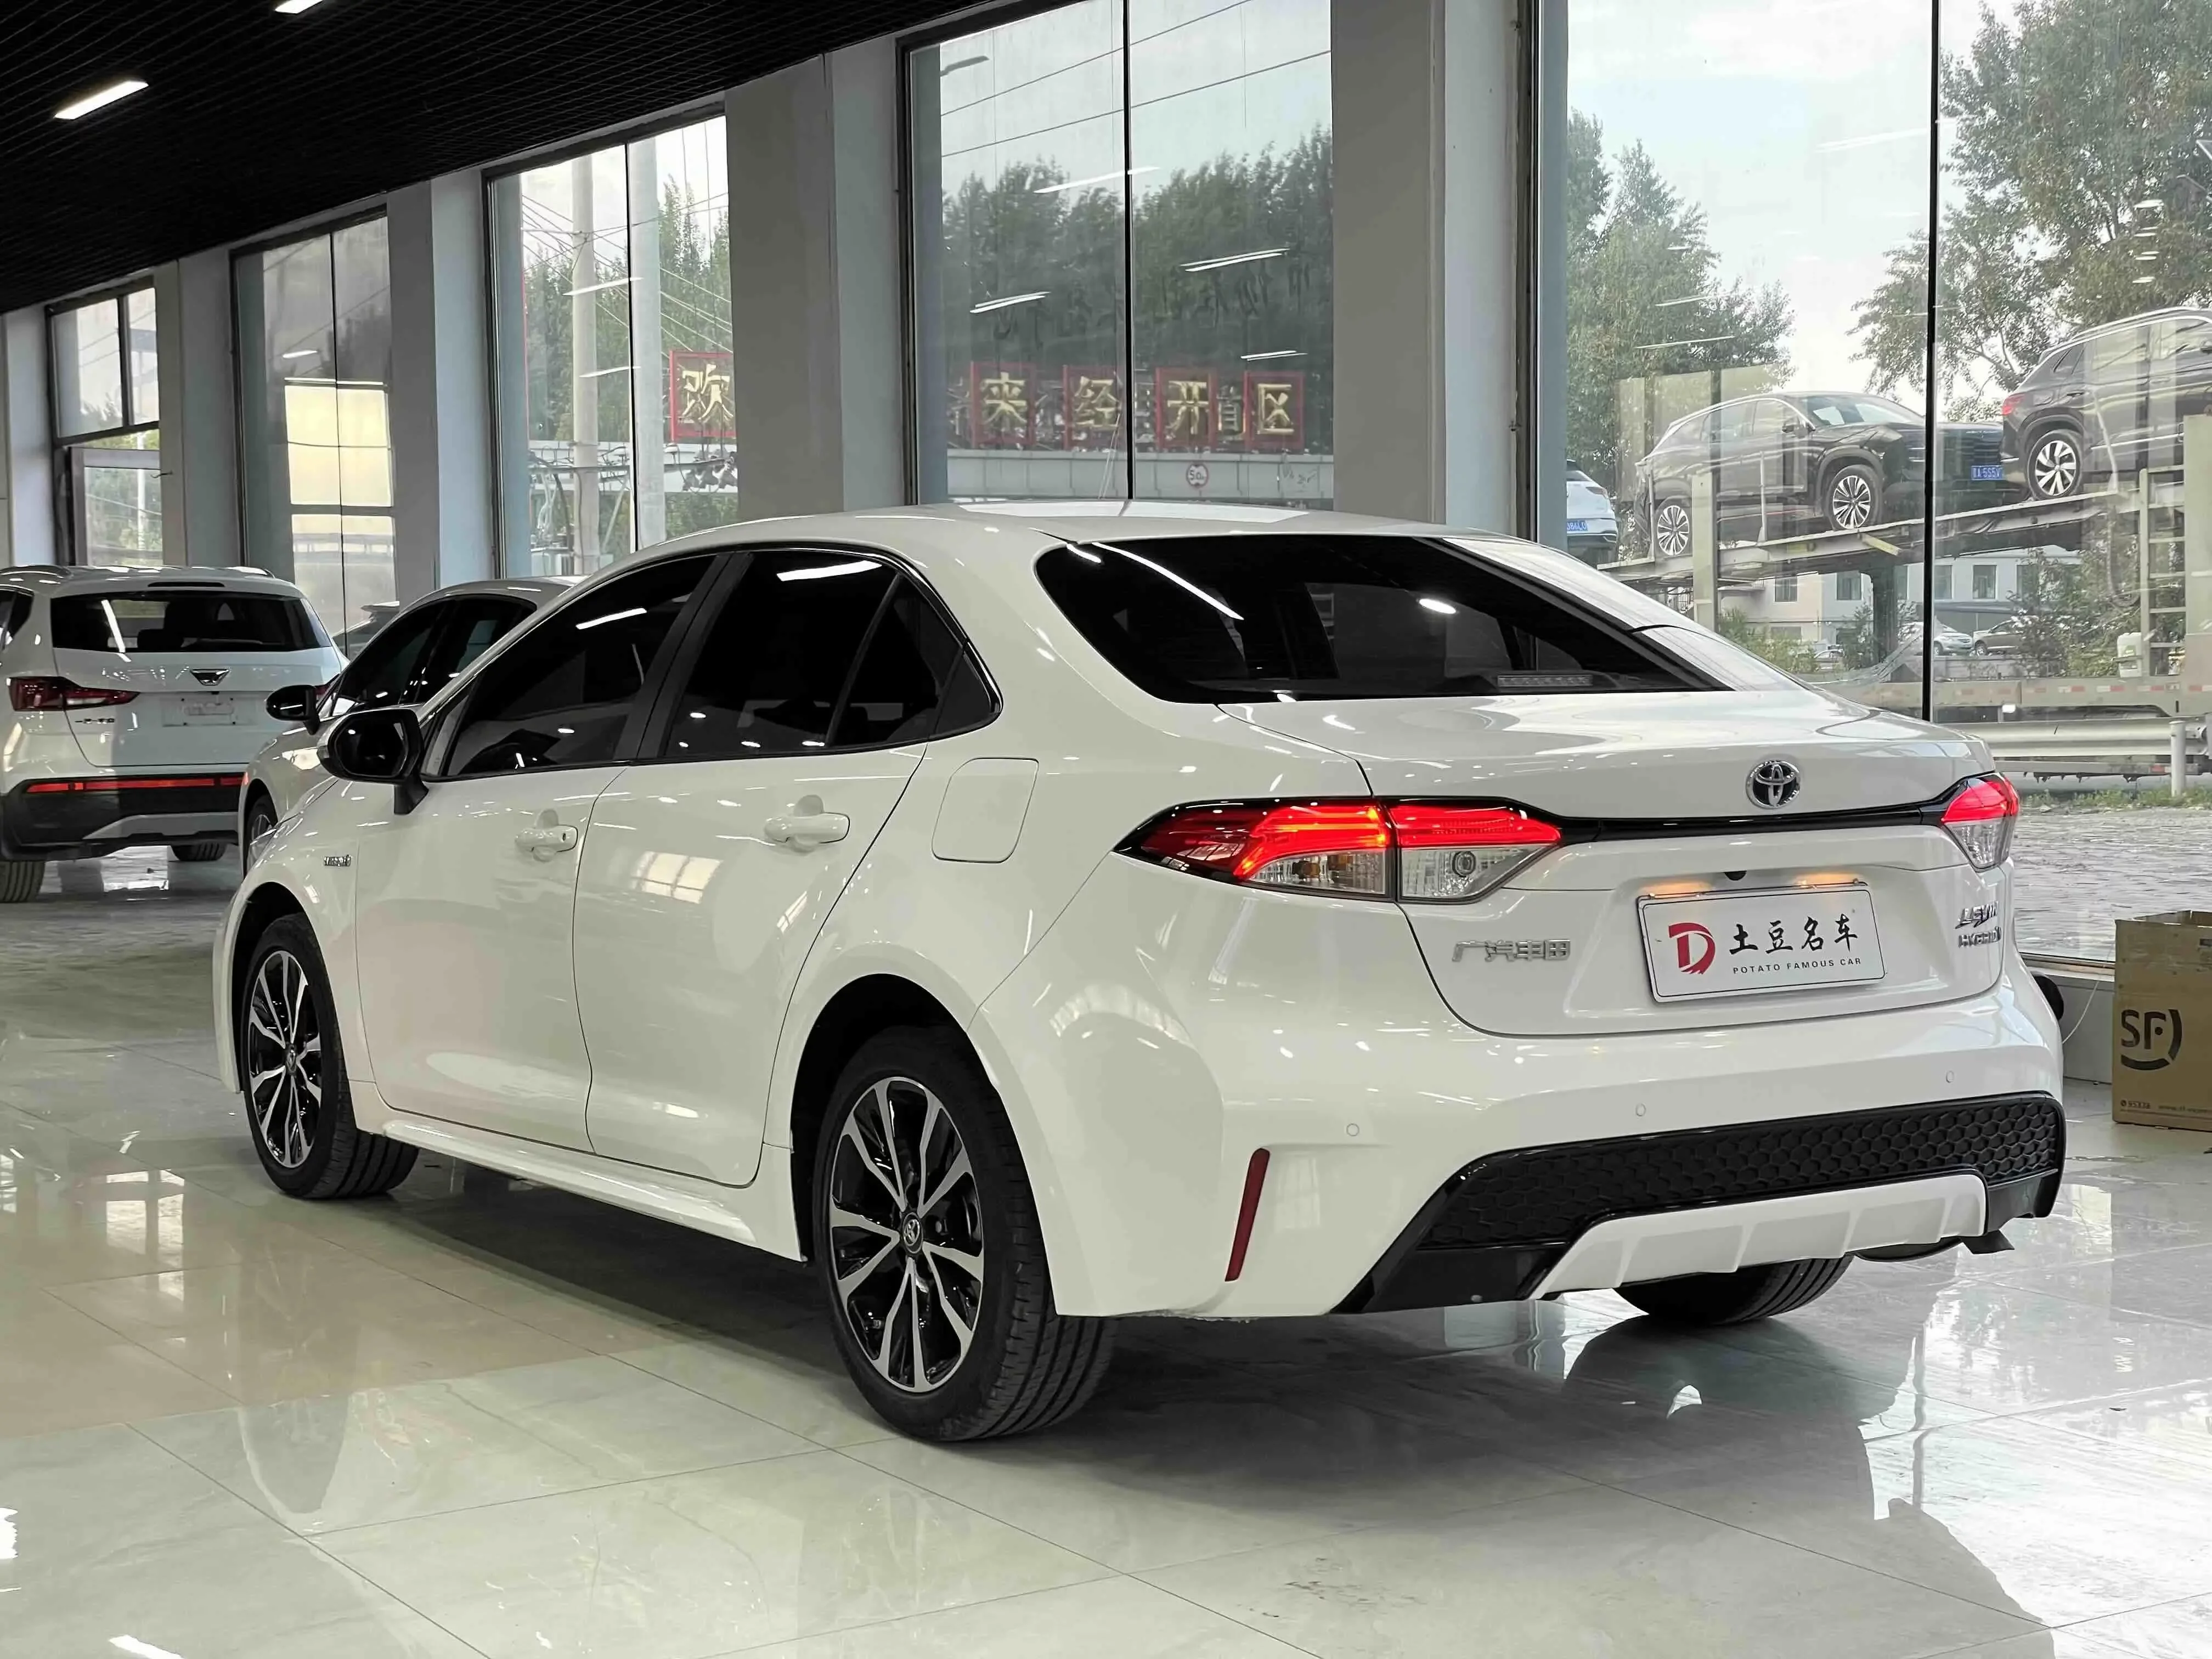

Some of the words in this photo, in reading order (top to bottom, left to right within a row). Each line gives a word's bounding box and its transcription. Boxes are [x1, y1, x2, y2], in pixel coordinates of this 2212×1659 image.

[1729, 913, 1858, 955] 土豆名车
[1733, 963, 1781, 974] POTATO
[1786, 959, 1835, 969] FAMOUS
[1839, 957, 1861, 966] CAR
[2121, 1009, 2166, 1049] SF
